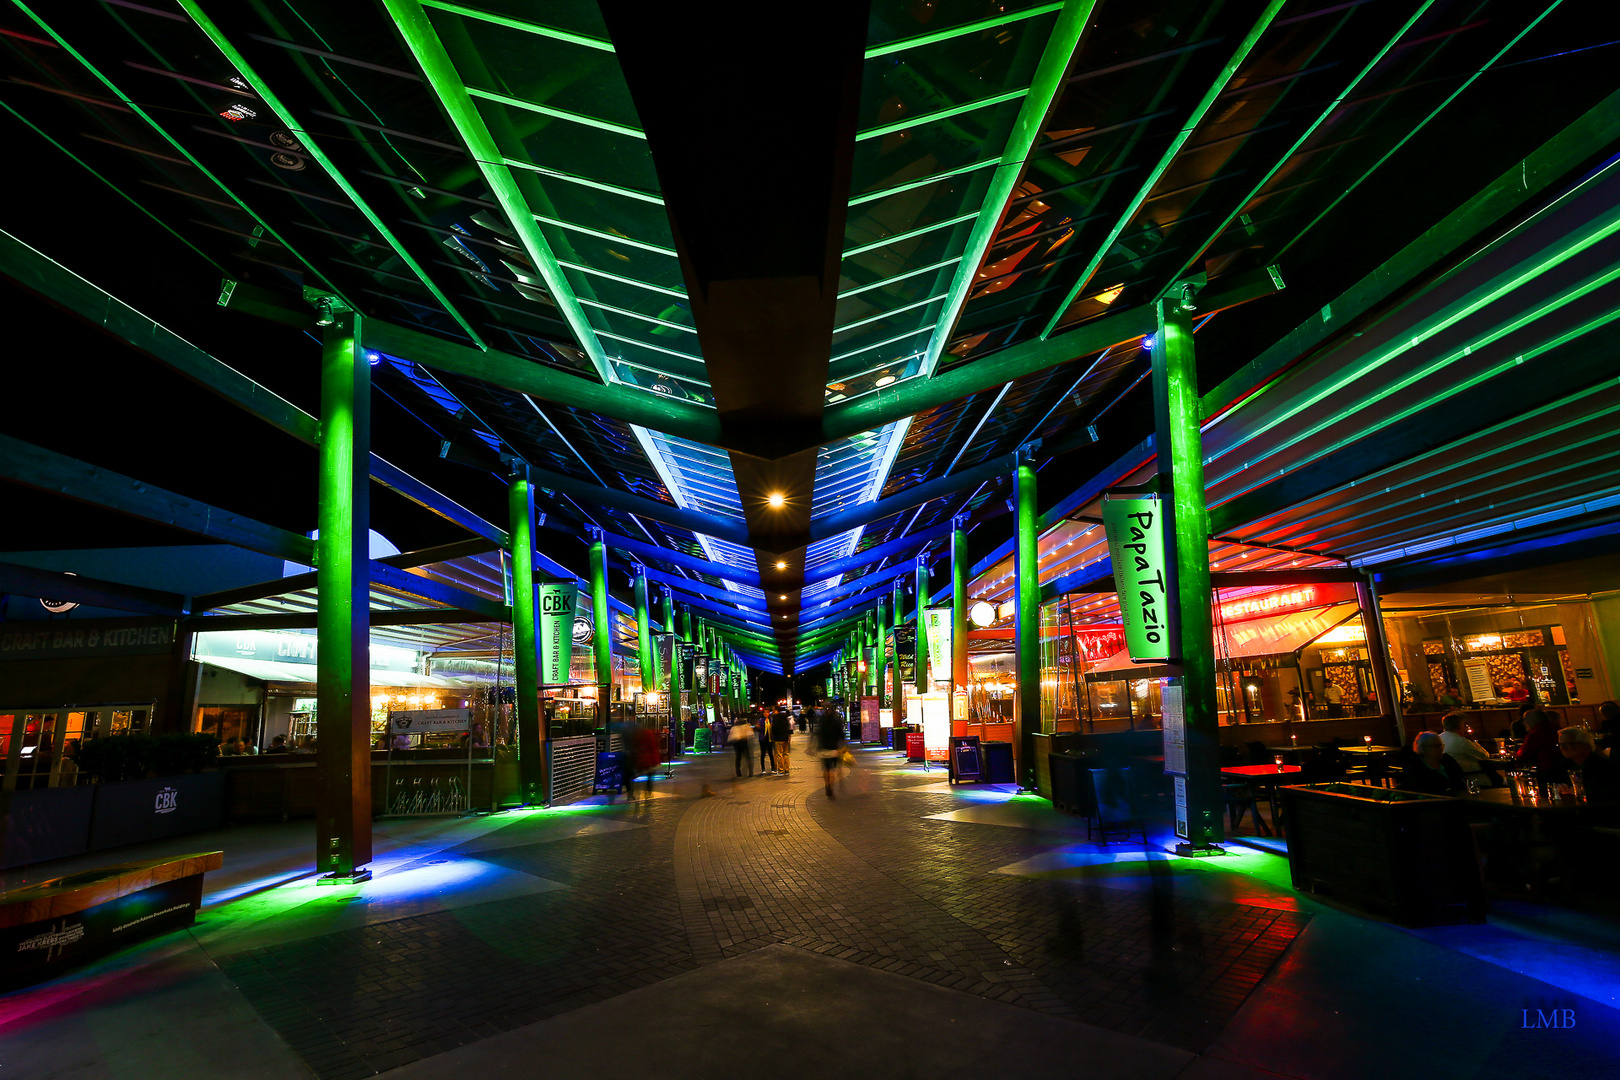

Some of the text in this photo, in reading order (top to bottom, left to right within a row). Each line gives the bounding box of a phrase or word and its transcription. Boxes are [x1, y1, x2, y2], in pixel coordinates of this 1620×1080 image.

[1123, 511, 1166, 644] Papa Tazio
[543, 595, 571, 611] CBK
[1221, 590, 1313, 618] RESTAURANT
[2, 627, 170, 651] CRAFT BAR & KITCHEN
[553, 620, 561, 645] KITCHEN
[552, 651, 560, 663] BAR
[658, 646, 669, 677] Solace
[155, 791, 178, 810] CBK
